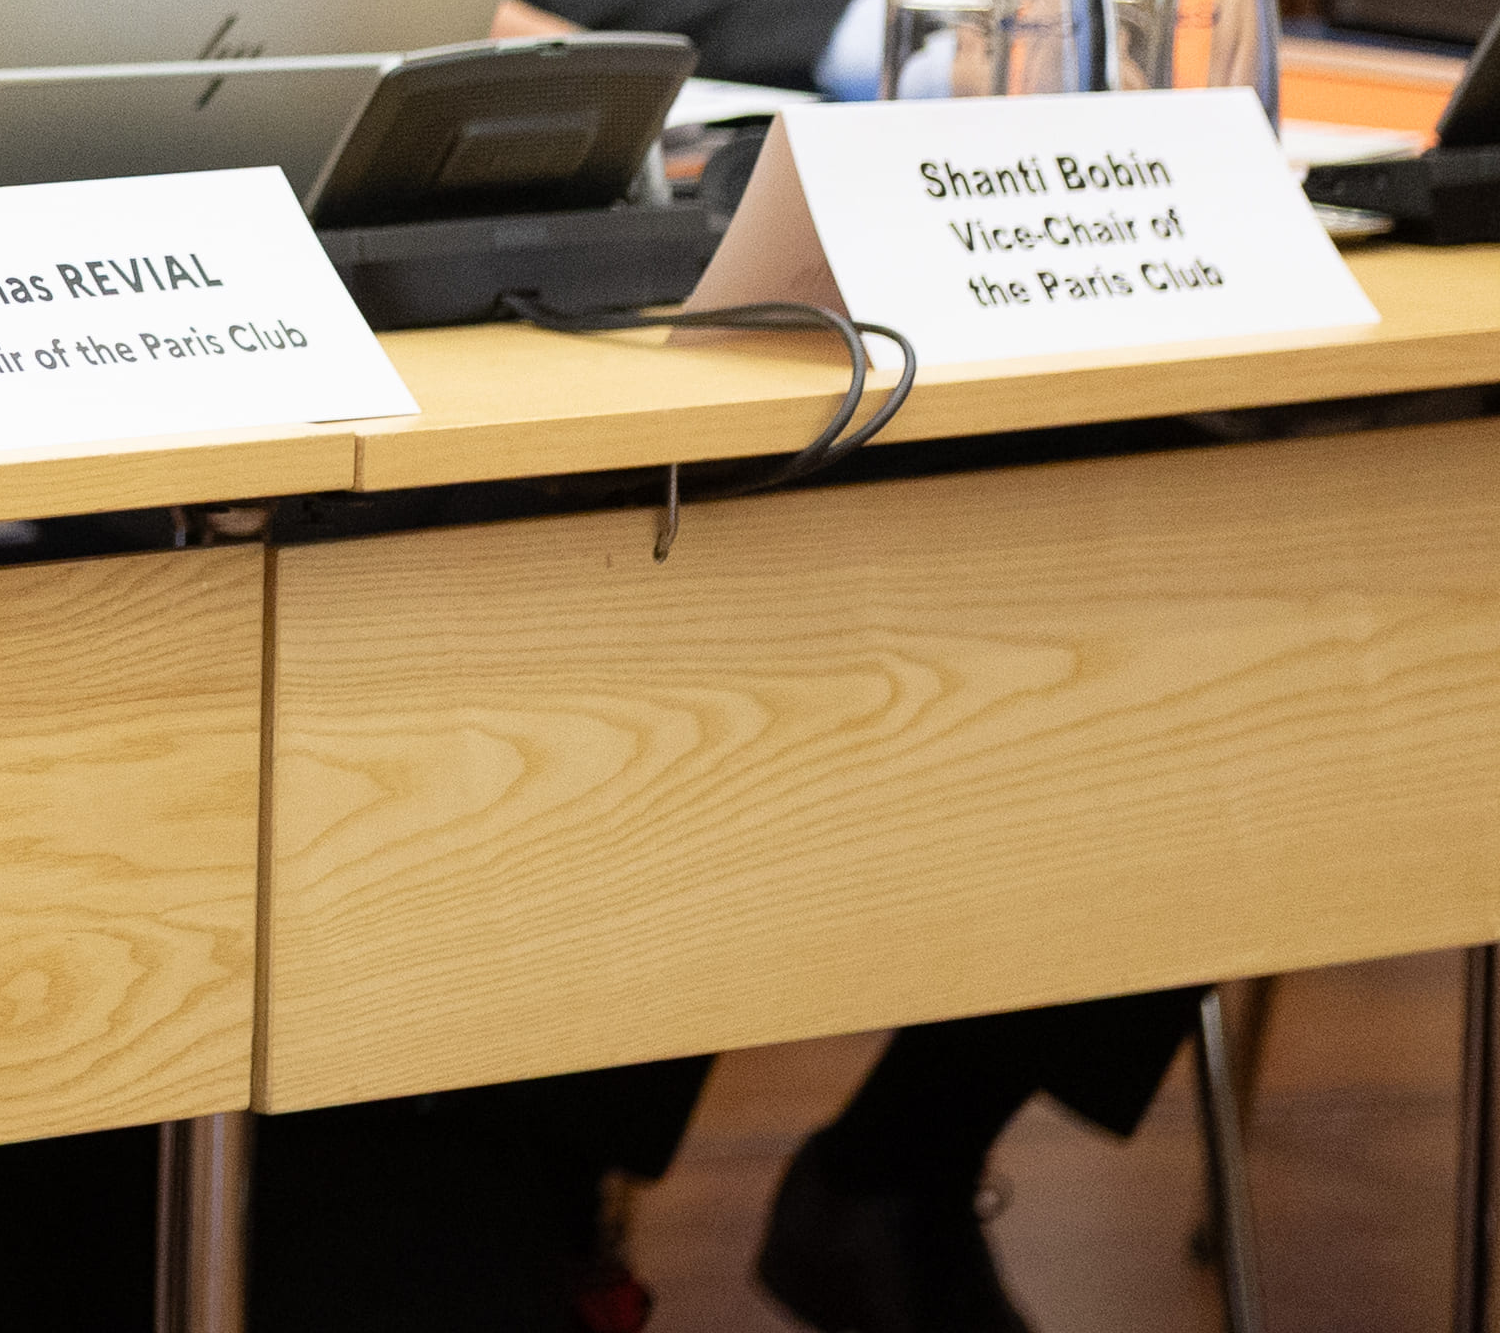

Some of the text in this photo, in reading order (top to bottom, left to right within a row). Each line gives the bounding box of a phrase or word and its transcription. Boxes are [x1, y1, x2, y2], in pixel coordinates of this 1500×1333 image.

[919, 153, 1171, 200] Shanti Bobin
[949, 207, 1184, 253] Vice-Chair of
[56, 253, 223, 299] REVIAL
[967, 260, 1224, 307] the Paris Club
[34, 338, 70, 371] of
[76, 336, 136, 366] the
[143, 326, 226, 360] Paris
[228, 320, 308, 353] Club
